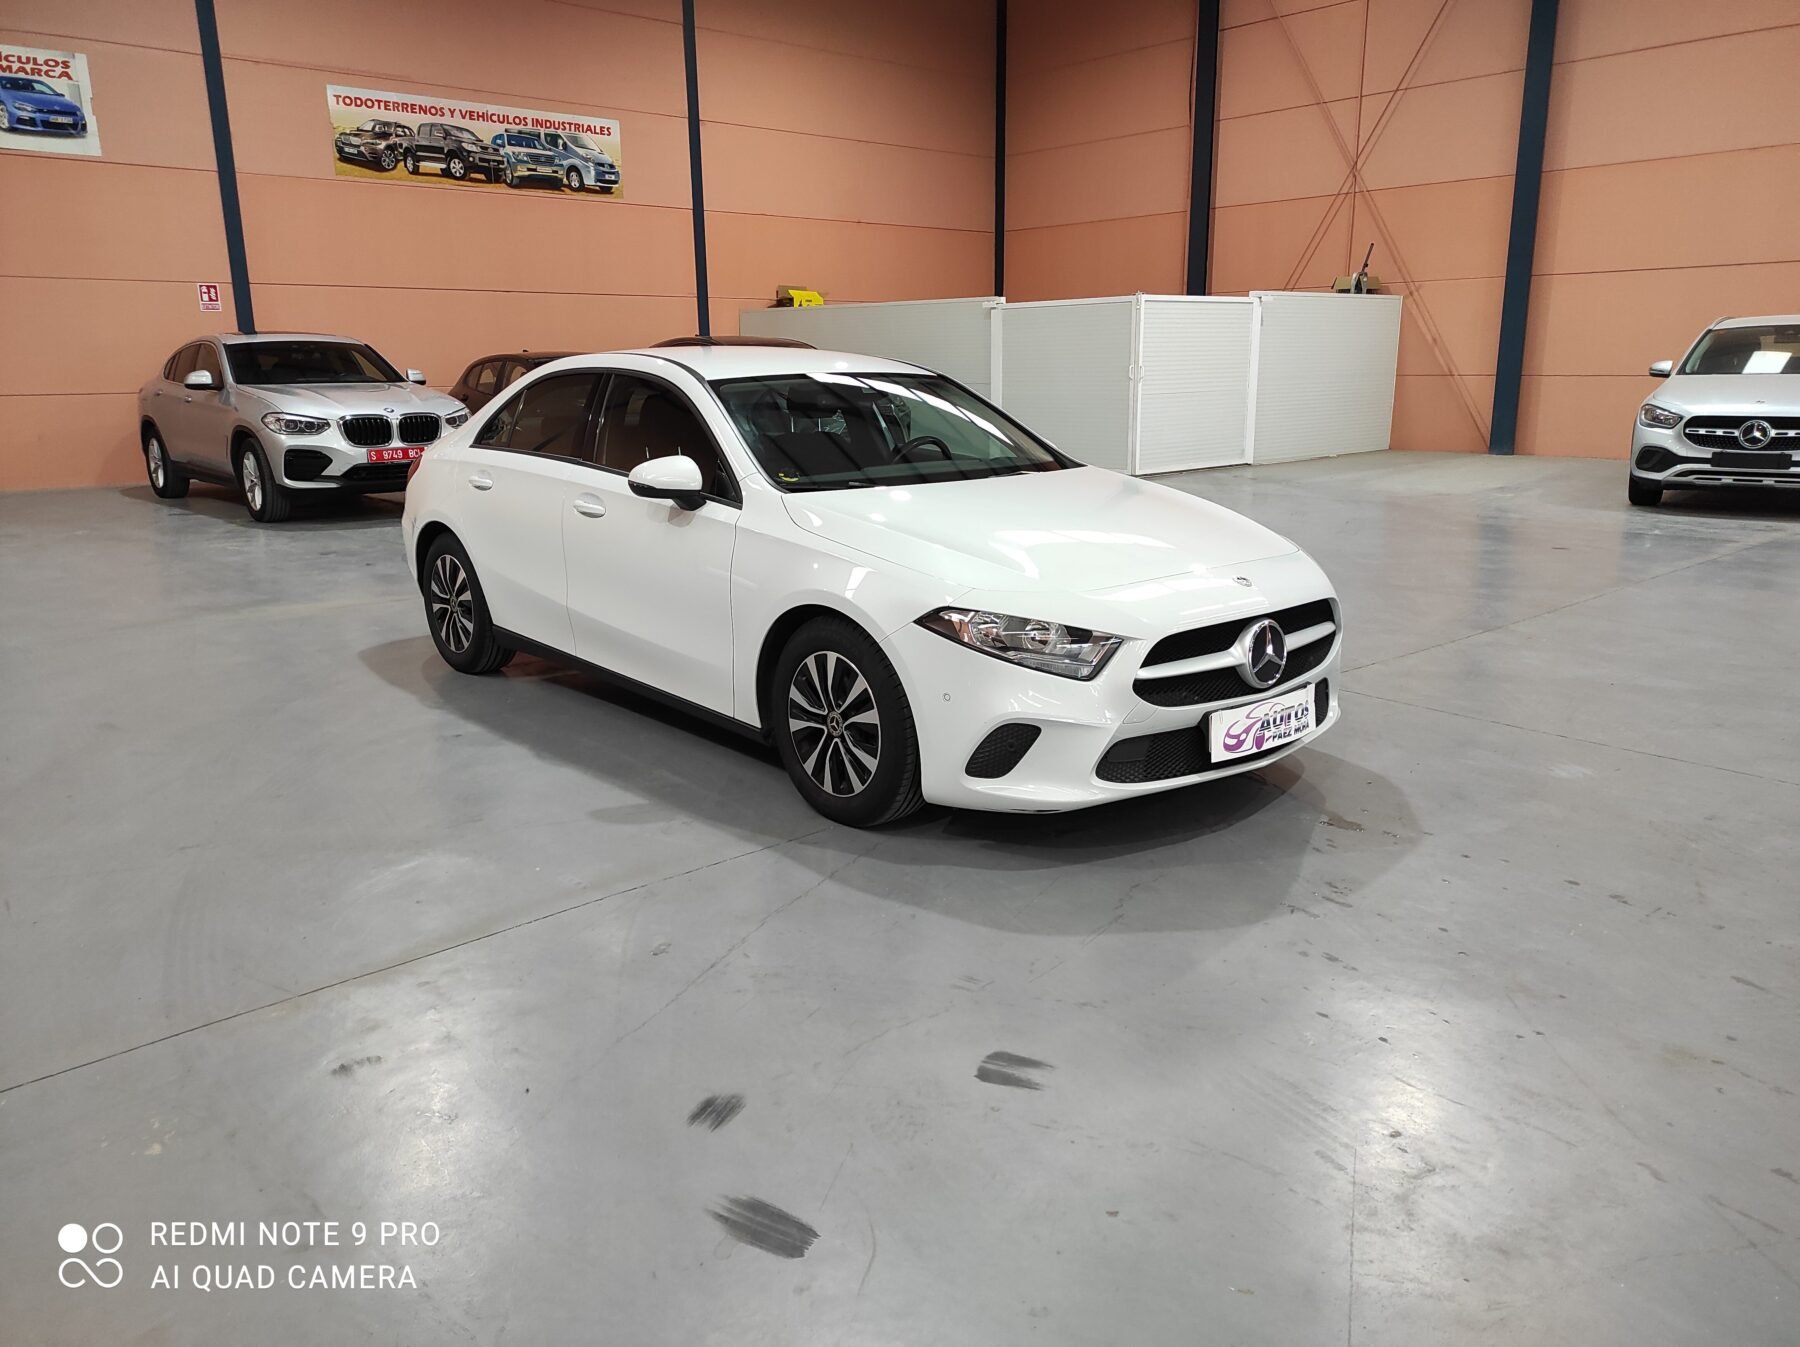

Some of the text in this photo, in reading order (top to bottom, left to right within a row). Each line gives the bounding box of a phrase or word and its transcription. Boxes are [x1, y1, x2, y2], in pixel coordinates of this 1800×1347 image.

[333, 94, 612, 137] TODOTERRENOS Y VEHÍCULOS INDUSTRIALES
[370, 451, 377, 460] S
[383, 450, 403, 459] 9749
[1259, 700, 1309, 732] AUTOS
